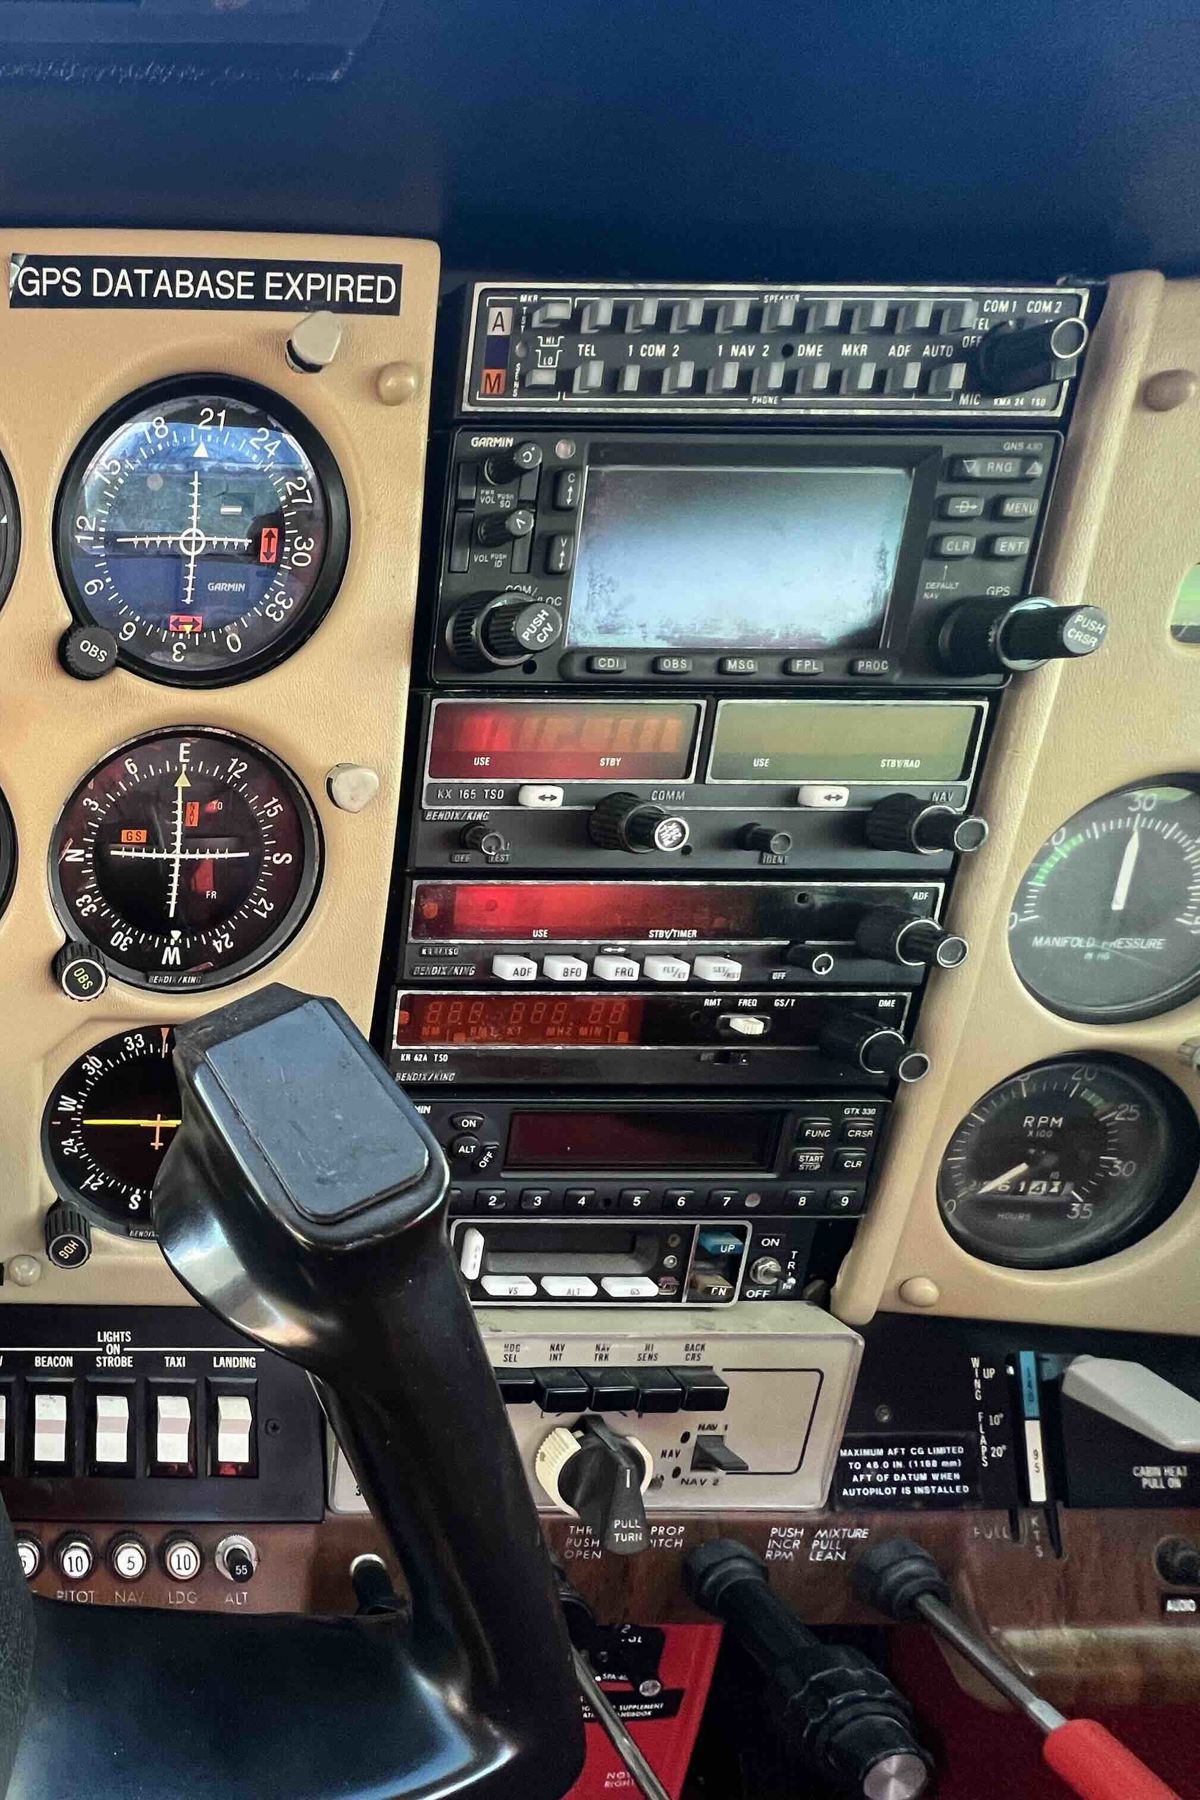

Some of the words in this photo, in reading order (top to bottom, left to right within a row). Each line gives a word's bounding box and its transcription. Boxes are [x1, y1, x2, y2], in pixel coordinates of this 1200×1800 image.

[18, 266, 82, 297] GPS
[92, 268, 254, 300] DATABASE
[265, 271, 396, 304] EXPIRED
[972, 318, 989, 329] TEL
[578, 345, 596, 356] TEL
[628, 345, 633, 356] 1
[640, 345, 665, 357] COM
[673, 345, 679, 357] 2
[718, 345, 723, 356] 1
[731, 345, 754, 357] NAV
[762, 345, 769, 357] 2
[798, 345, 823, 356] DME
[841, 345, 868, 356] MKR
[888, 345, 912, 357] ADF
[923, 345, 953, 357] AUTO
[959, 394, 981, 405] MIC
[198, 408, 226, 429] 21
[249, 428, 281, 458] 24
[471, 437, 513, 447] GARMIN
[987, 462, 1012, 473] RNG
[285, 477, 313, 505] 27
[1005, 502, 1035, 513] MENU
[75, 515, 95, 543] 12
[291, 536, 314, 567] 30
[946, 542, 970, 550] CLR
[1000, 542, 1023, 551] ENT
[208, 582, 245, 592] GARMIN
[265, 590, 293, 623] 33
[79, 639, 108, 662] OBS
[598, 658, 619, 668] CDI
[663, 659, 687, 669] OBS
[727, 660, 754, 670] MSG
[796, 660, 819, 670] FPL
[858, 661, 888, 670] PROC
[179, 743, 190, 763] E
[474, 758, 490, 766] USE
[600, 758, 621, 766] STBY
[753, 758, 769, 767] USE
[880, 759, 920, 768] STBY/RAD
[229, 758, 248, 779] 12
[438, 790, 451, 798] KX
[459, 790, 476, 799] 165
[484, 790, 504, 799] TSO
[651, 791, 685, 800] COMM
[426, 812, 489, 820] BENDIX/KING
[649, 930, 697, 938] STBY/TIMER
[1032, 936, 1095, 948] MANIFOLD
[513, 967, 532, 976] ADF
[615, 968, 634, 978] FRQ
[738, 999, 757, 1007] FREQ
[879, 1000, 895, 1008] DME
[123, 1033, 145, 1051] 33
[1115, 1104, 1140, 1120] 25
[462, 1120, 476, 1128] ON
[1023, 1117, 1063, 1128] RPM
[1109, 1161, 1136, 1176] 30
[1067, 1203, 1093, 1219] 35
[761, 1238, 780, 1246] ON
[746, 1290, 770, 1298] OFF
[97, 1331, 131, 1342] LIGHTS
[684, 1344, 705, 1352] BACK
[35, 1356, 73, 1367] BEACON
[96, 1356, 133, 1368] STROBE
[164, 1356, 185, 1367] TAXI
[213, 1357, 256, 1368] LANDING
[928, 1446, 964, 1454] LIMITED
[876, 1474, 889, 1482] OF
[894, 1473, 927, 1481] DATUM
[843, 1487, 897, 1496] AUTOPILOT
[914, 1485, 969, 1494] INSTALLED
[614, 1519, 640, 1529] PULL
[651, 1526, 684, 1536] PROP
[771, 1528, 803, 1537] PUSH
[815, 1528, 869, 1539] MIXTURE
[614, 1533, 642, 1543] TURN
[768, 1539, 800, 1550] INCR
[812, 1540, 841, 1550] PULL
[564, 1550, 601, 1560] OPEN
[809, 1551, 846, 1561] LEAN
[57, 1591, 94, 1602] PITOT
